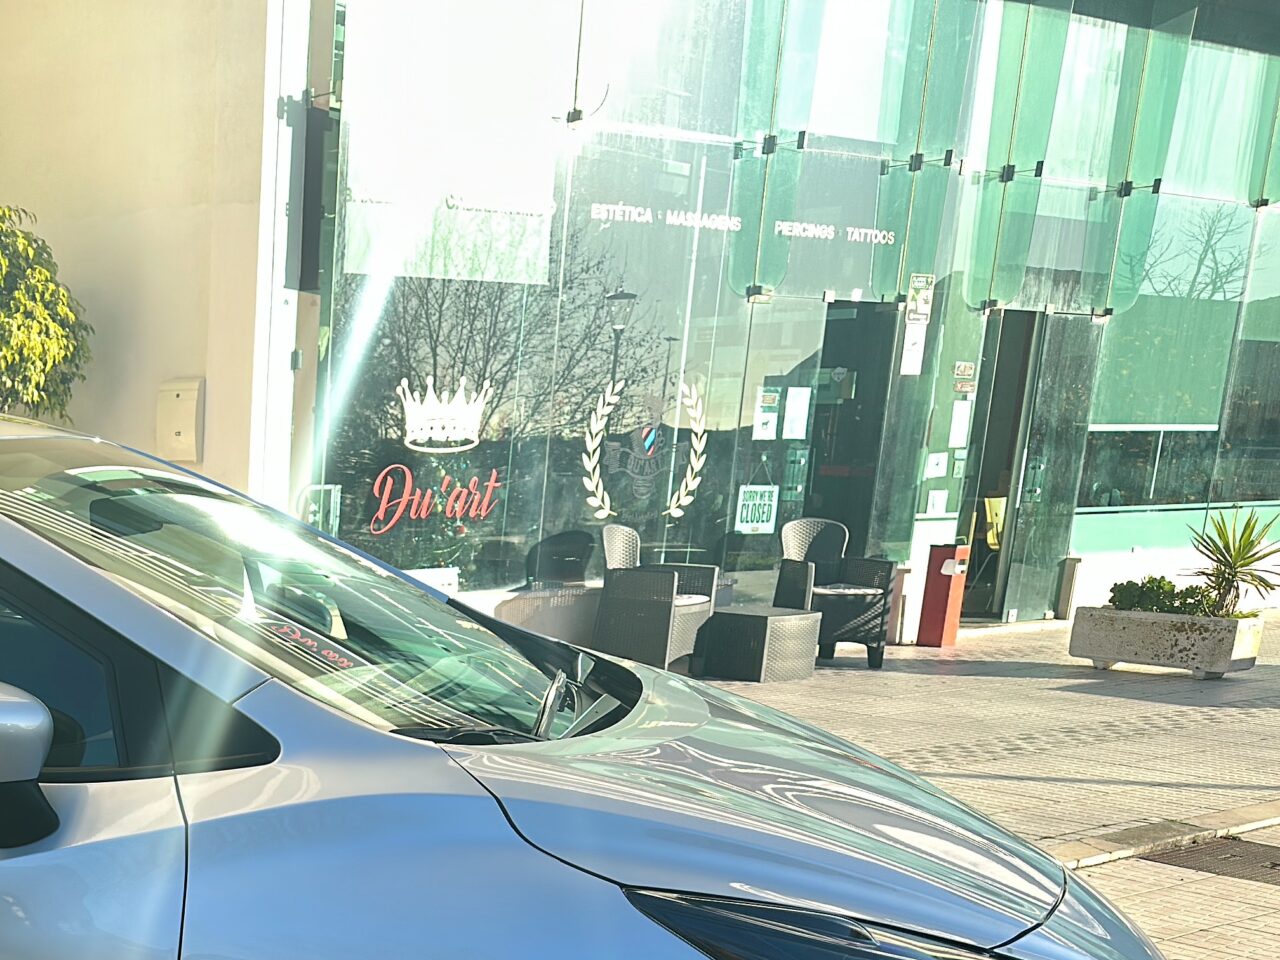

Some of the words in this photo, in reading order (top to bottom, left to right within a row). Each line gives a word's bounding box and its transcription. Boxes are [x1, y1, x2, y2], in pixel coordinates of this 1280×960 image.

[590, 200, 653, 224] ESTÉTICA
[665, 208, 742, 232] MASSAGENS
[774, 220, 835, 240] PIERCINGS
[846, 226, 895, 245] TATTOOS
[370, 463, 502, 535] Du'art
[740, 503, 773, 524] CLOSED
